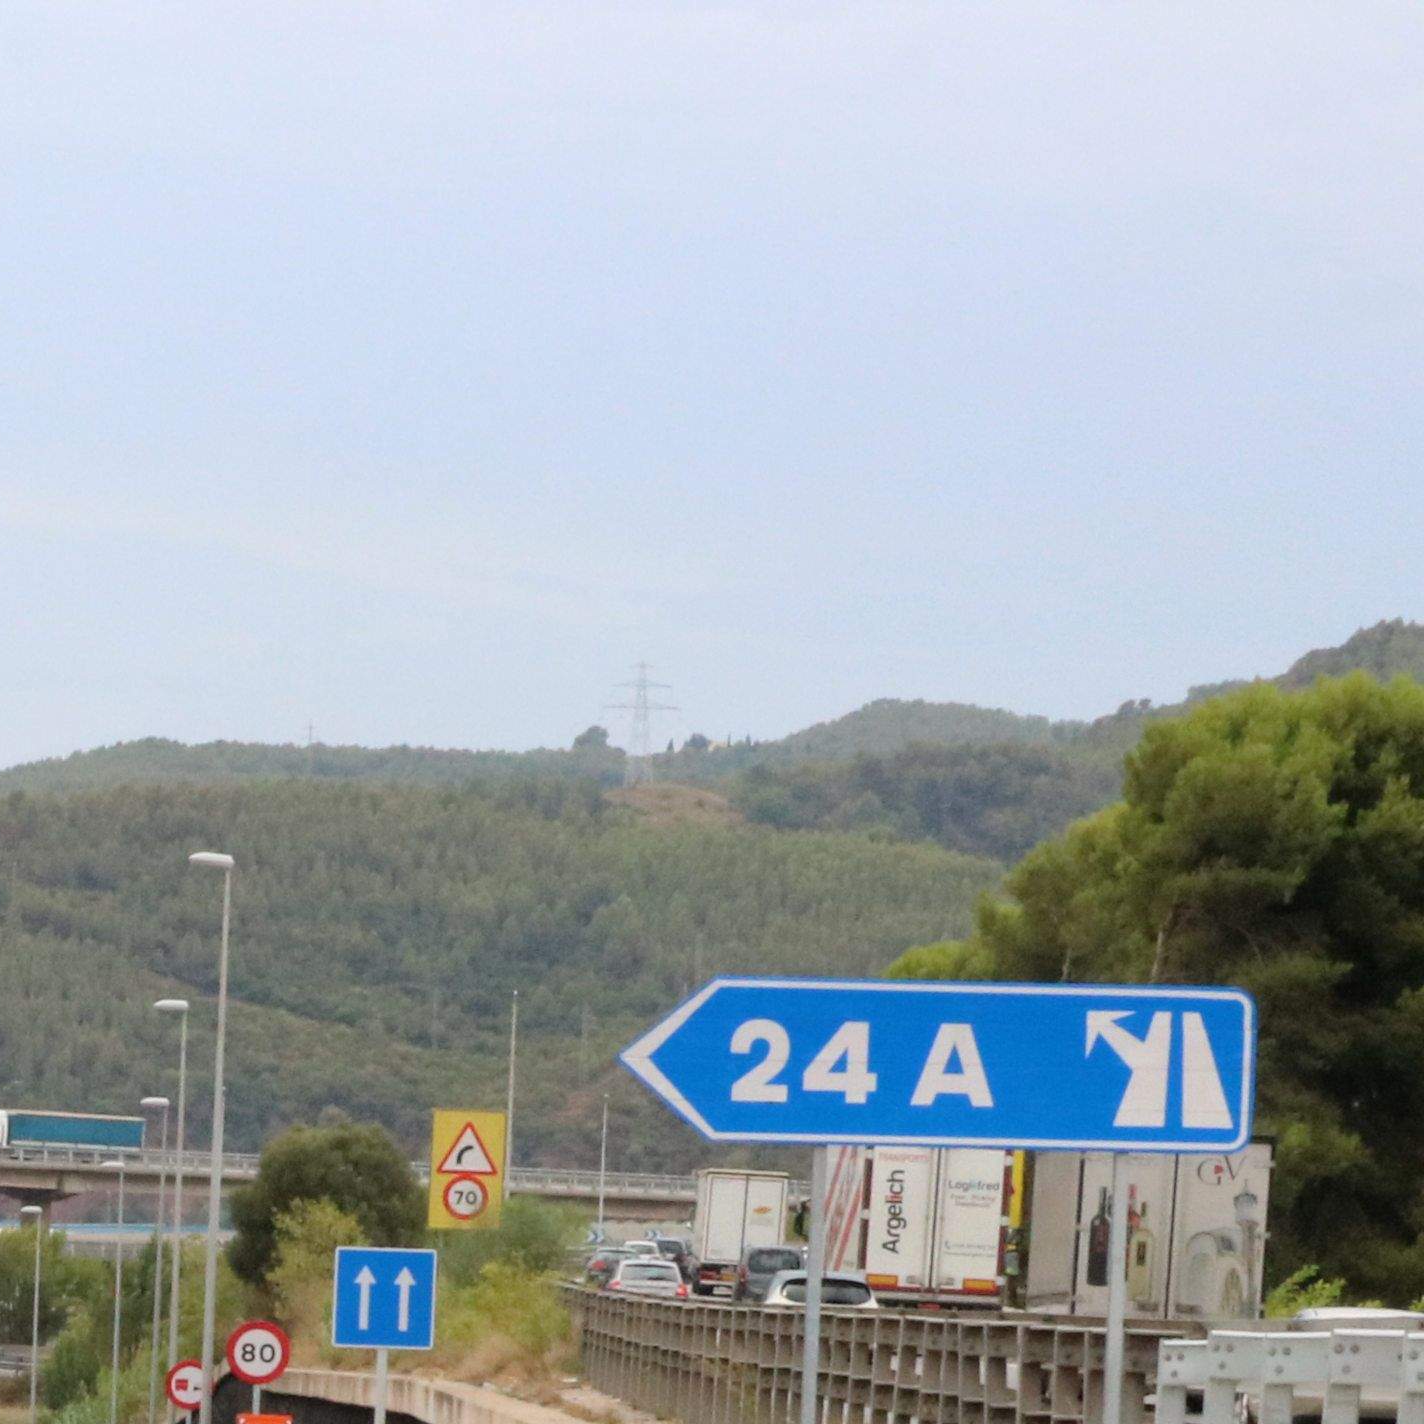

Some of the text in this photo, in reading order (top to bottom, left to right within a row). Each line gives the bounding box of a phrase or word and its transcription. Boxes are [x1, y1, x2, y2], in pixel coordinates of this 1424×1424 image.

[729, 1018, 995, 1107] 24 A
[453, 1190, 478, 1205] 70
[881, 1169, 908, 1255] Argelich
[241, 1343, 276, 1363] 80
